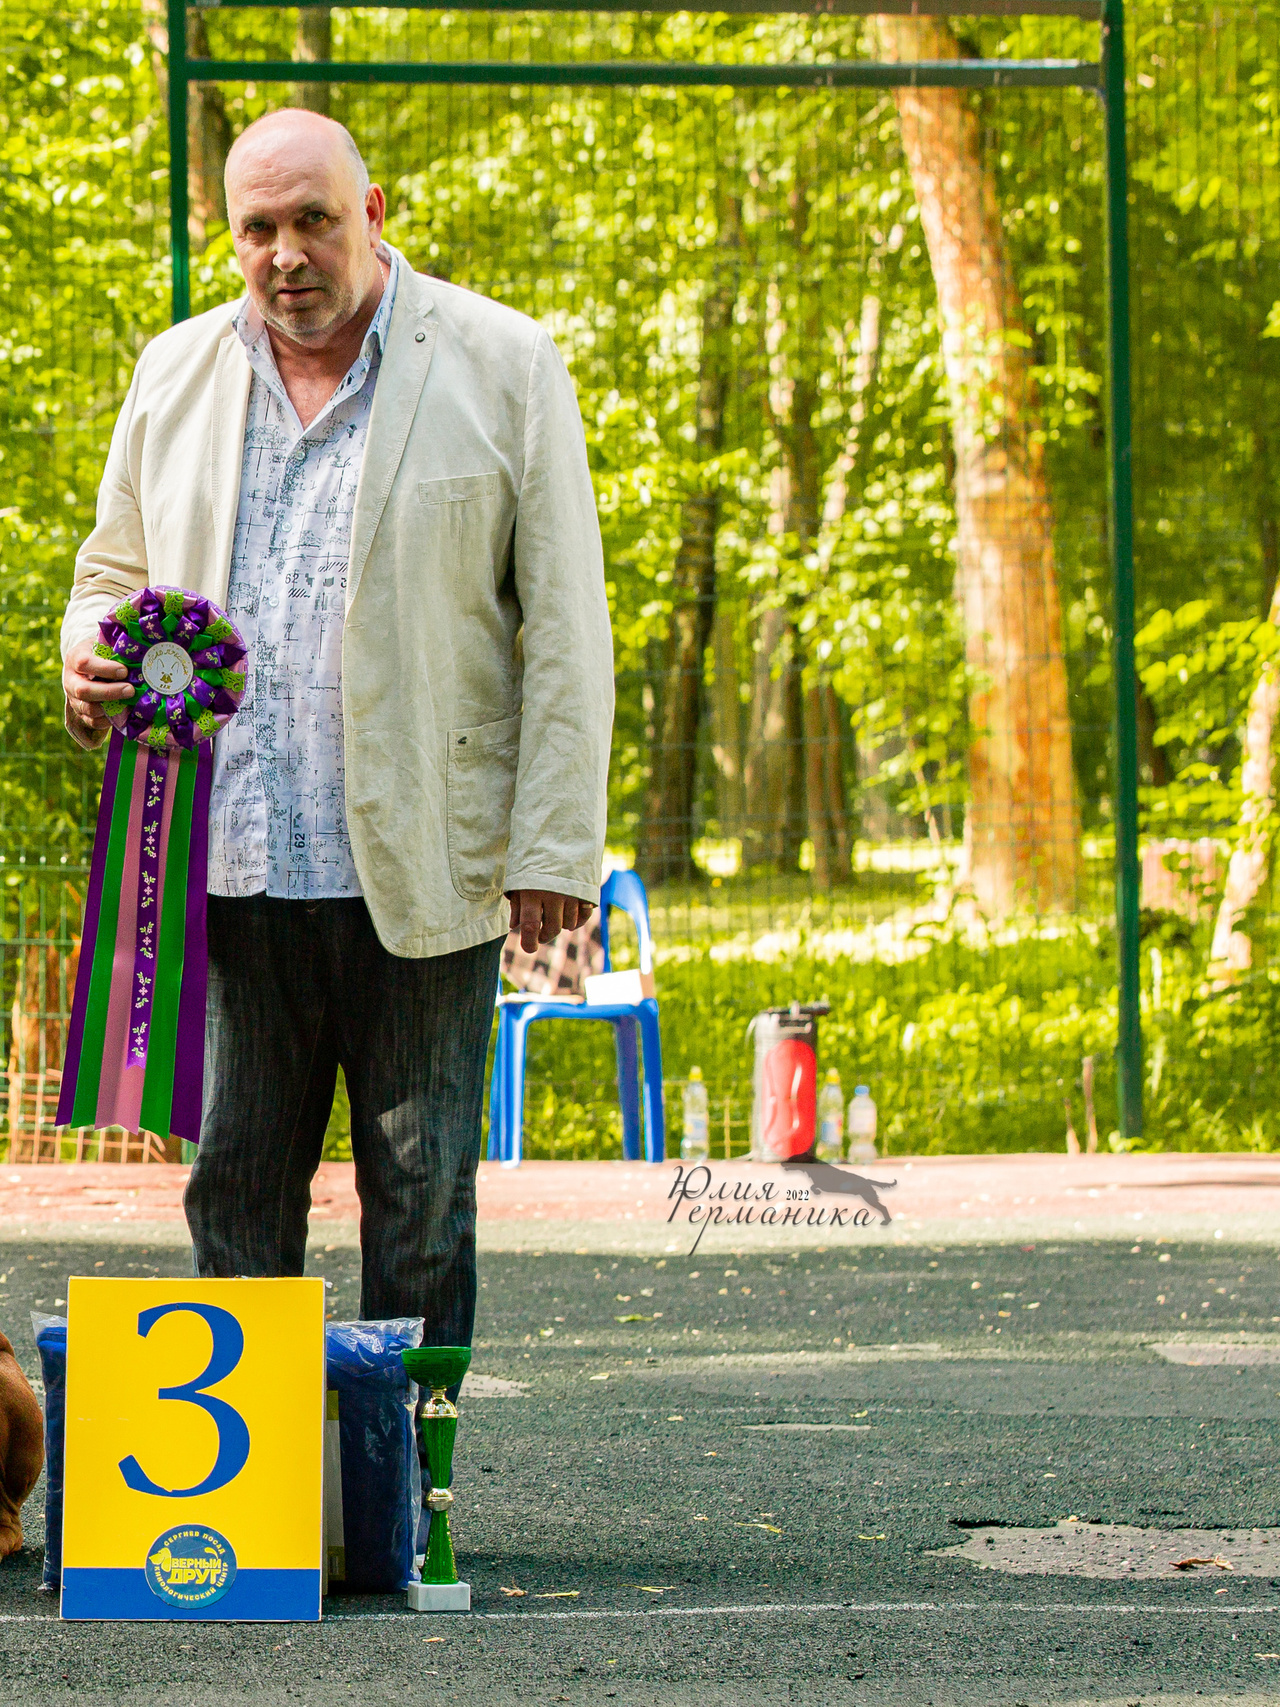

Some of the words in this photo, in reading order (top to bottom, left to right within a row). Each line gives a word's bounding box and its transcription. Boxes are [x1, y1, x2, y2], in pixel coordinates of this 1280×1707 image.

[294, 833, 306, 848] 62
[117, 1302, 251, 1498] 3
[163, 1530, 200, 1547] СЕРГИЕВ
[202, 1532, 226, 1555] ПОСАД
[171, 1557, 222, 1568] ВЕРНЫЙ
[154, 1565, 217, 1601] КИНОЛОГИЧЕСКИЙ
[215, 1562, 229, 1588] ЦЕНТР
[167, 1568, 222, 1585] ДРУГ
